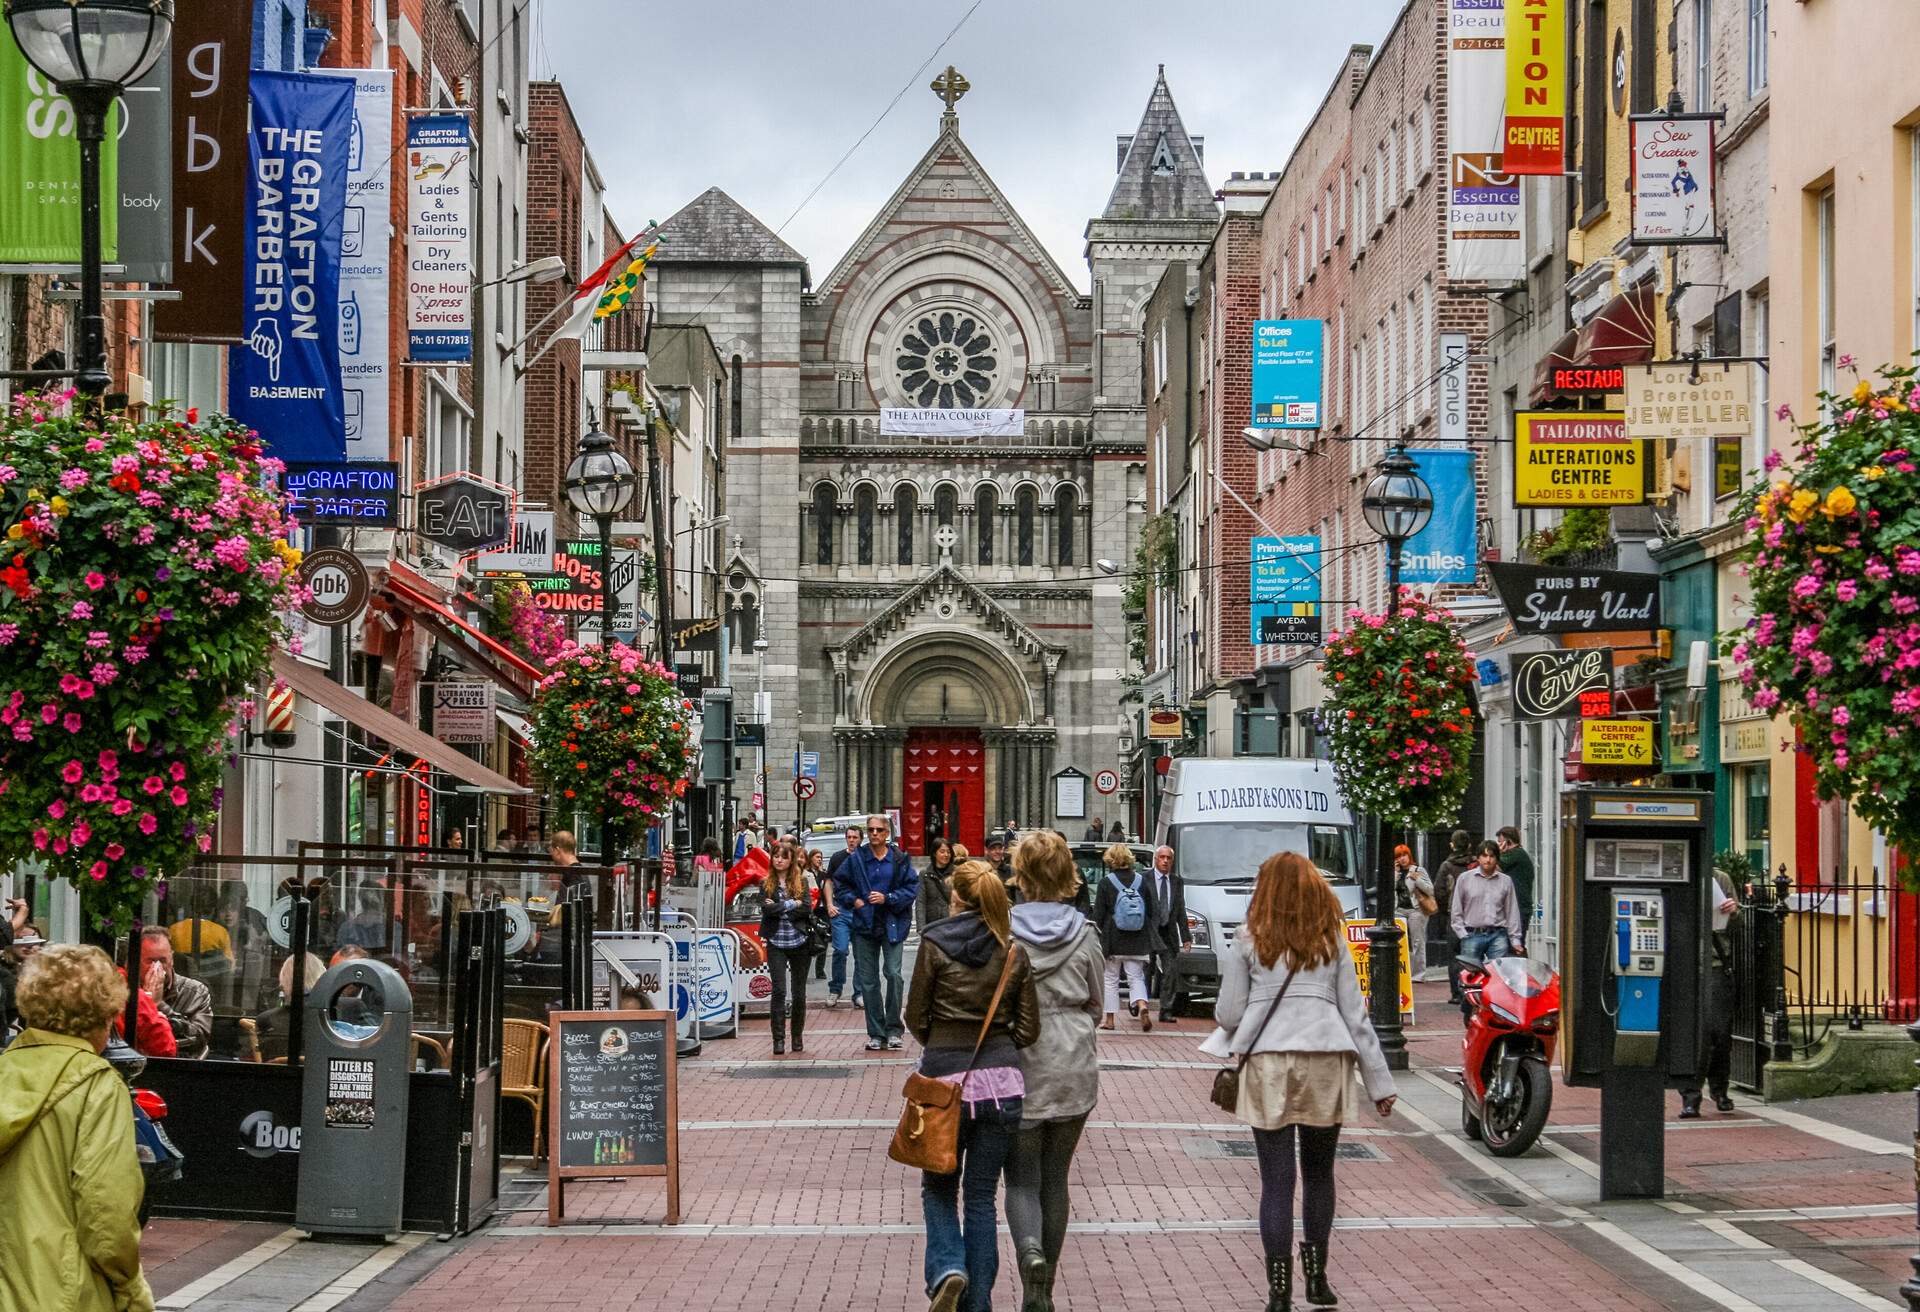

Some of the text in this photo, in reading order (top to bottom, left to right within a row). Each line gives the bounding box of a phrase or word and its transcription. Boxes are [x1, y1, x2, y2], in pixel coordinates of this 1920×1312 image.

[1454, 15, 1504, 27] Beau
[1508, 127, 1560, 145] CENTRE
[1654, 121, 1692, 142] Sew
[262, 128, 323, 153] THE
[1642, 142, 1699, 160] Creative
[26, 180, 80, 190] DENTA
[420, 184, 460, 195] Ladies
[123, 193, 161, 210] body
[435, 198, 444, 208] &
[1454, 190, 1519, 203] Essence
[421, 212, 458, 222] Gents
[1450, 210, 1517, 225] Beauty
[255, 158, 285, 312] BARBER
[412, 225, 467, 238] Tailoring
[289, 158, 322, 340] GRAFTON
[428, 247, 450, 260] Dry
[412, 260, 467, 271] Cleaners
[410, 282, 468, 294] One Hour
[416, 296, 463, 310] Xpress
[416, 312, 464, 322] Services
[1258, 326, 1292, 336] Offices
[411, 336, 469, 344] Ph: 01 6717813
[1258, 338, 1288, 347] To Let
[1555, 370, 1622, 388] RESTAUR
[1653, 371, 1723, 384] Loran
[250, 387, 326, 400] BASEMENT
[1643, 390, 1734, 402] Brereton
[888, 412, 992, 420] THE ALPHA COURSE
[1627, 405, 1750, 424] JEWELLER
[1536, 424, 1624, 438] TAILORING
[1528, 450, 1636, 466] ALTERATIONS
[307, 471, 394, 490] GRAFTON
[1552, 469, 1612, 485] CENTRE
[1528, 490, 1635, 500] LADIES & GENTS
[424, 495, 502, 538] EAT
[567, 542, 602, 556] WINE
[1257, 543, 1314, 552] Prime Retail
[302, 554, 359, 576] gourmet burger
[1400, 550, 1465, 570] Smiles
[610, 556, 634, 594] YLIST
[1258, 567, 1286, 575] To Let
[313, 574, 347, 596] gbk
[1536, 577, 1600, 589] FURS BY
[535, 592, 604, 612] OUNGE
[314, 608, 346, 616] kitchen
[1517, 591, 1654, 629] Sydney Vard
[1264, 632, 1318, 642] WHETSTONE
[1516, 652, 1609, 716] Cave
[1580, 692, 1610, 704] WINE
[1582, 704, 1610, 716] BAR
[1100, 776, 1112, 786] 50
[1306, 790, 1328, 812] LTD
[1636, 804, 1668, 813] eircom
[330, 1060, 374, 1072] LITTER IS
[330, 1072, 374, 1082] DISGUSTING
[330, 1090, 372, 1099] RESPONSIBLE
[352, 1084, 372, 1092] THOSE
[256, 1120, 302, 1150] Boc
[566, 1131, 594, 1140] LUNCH
